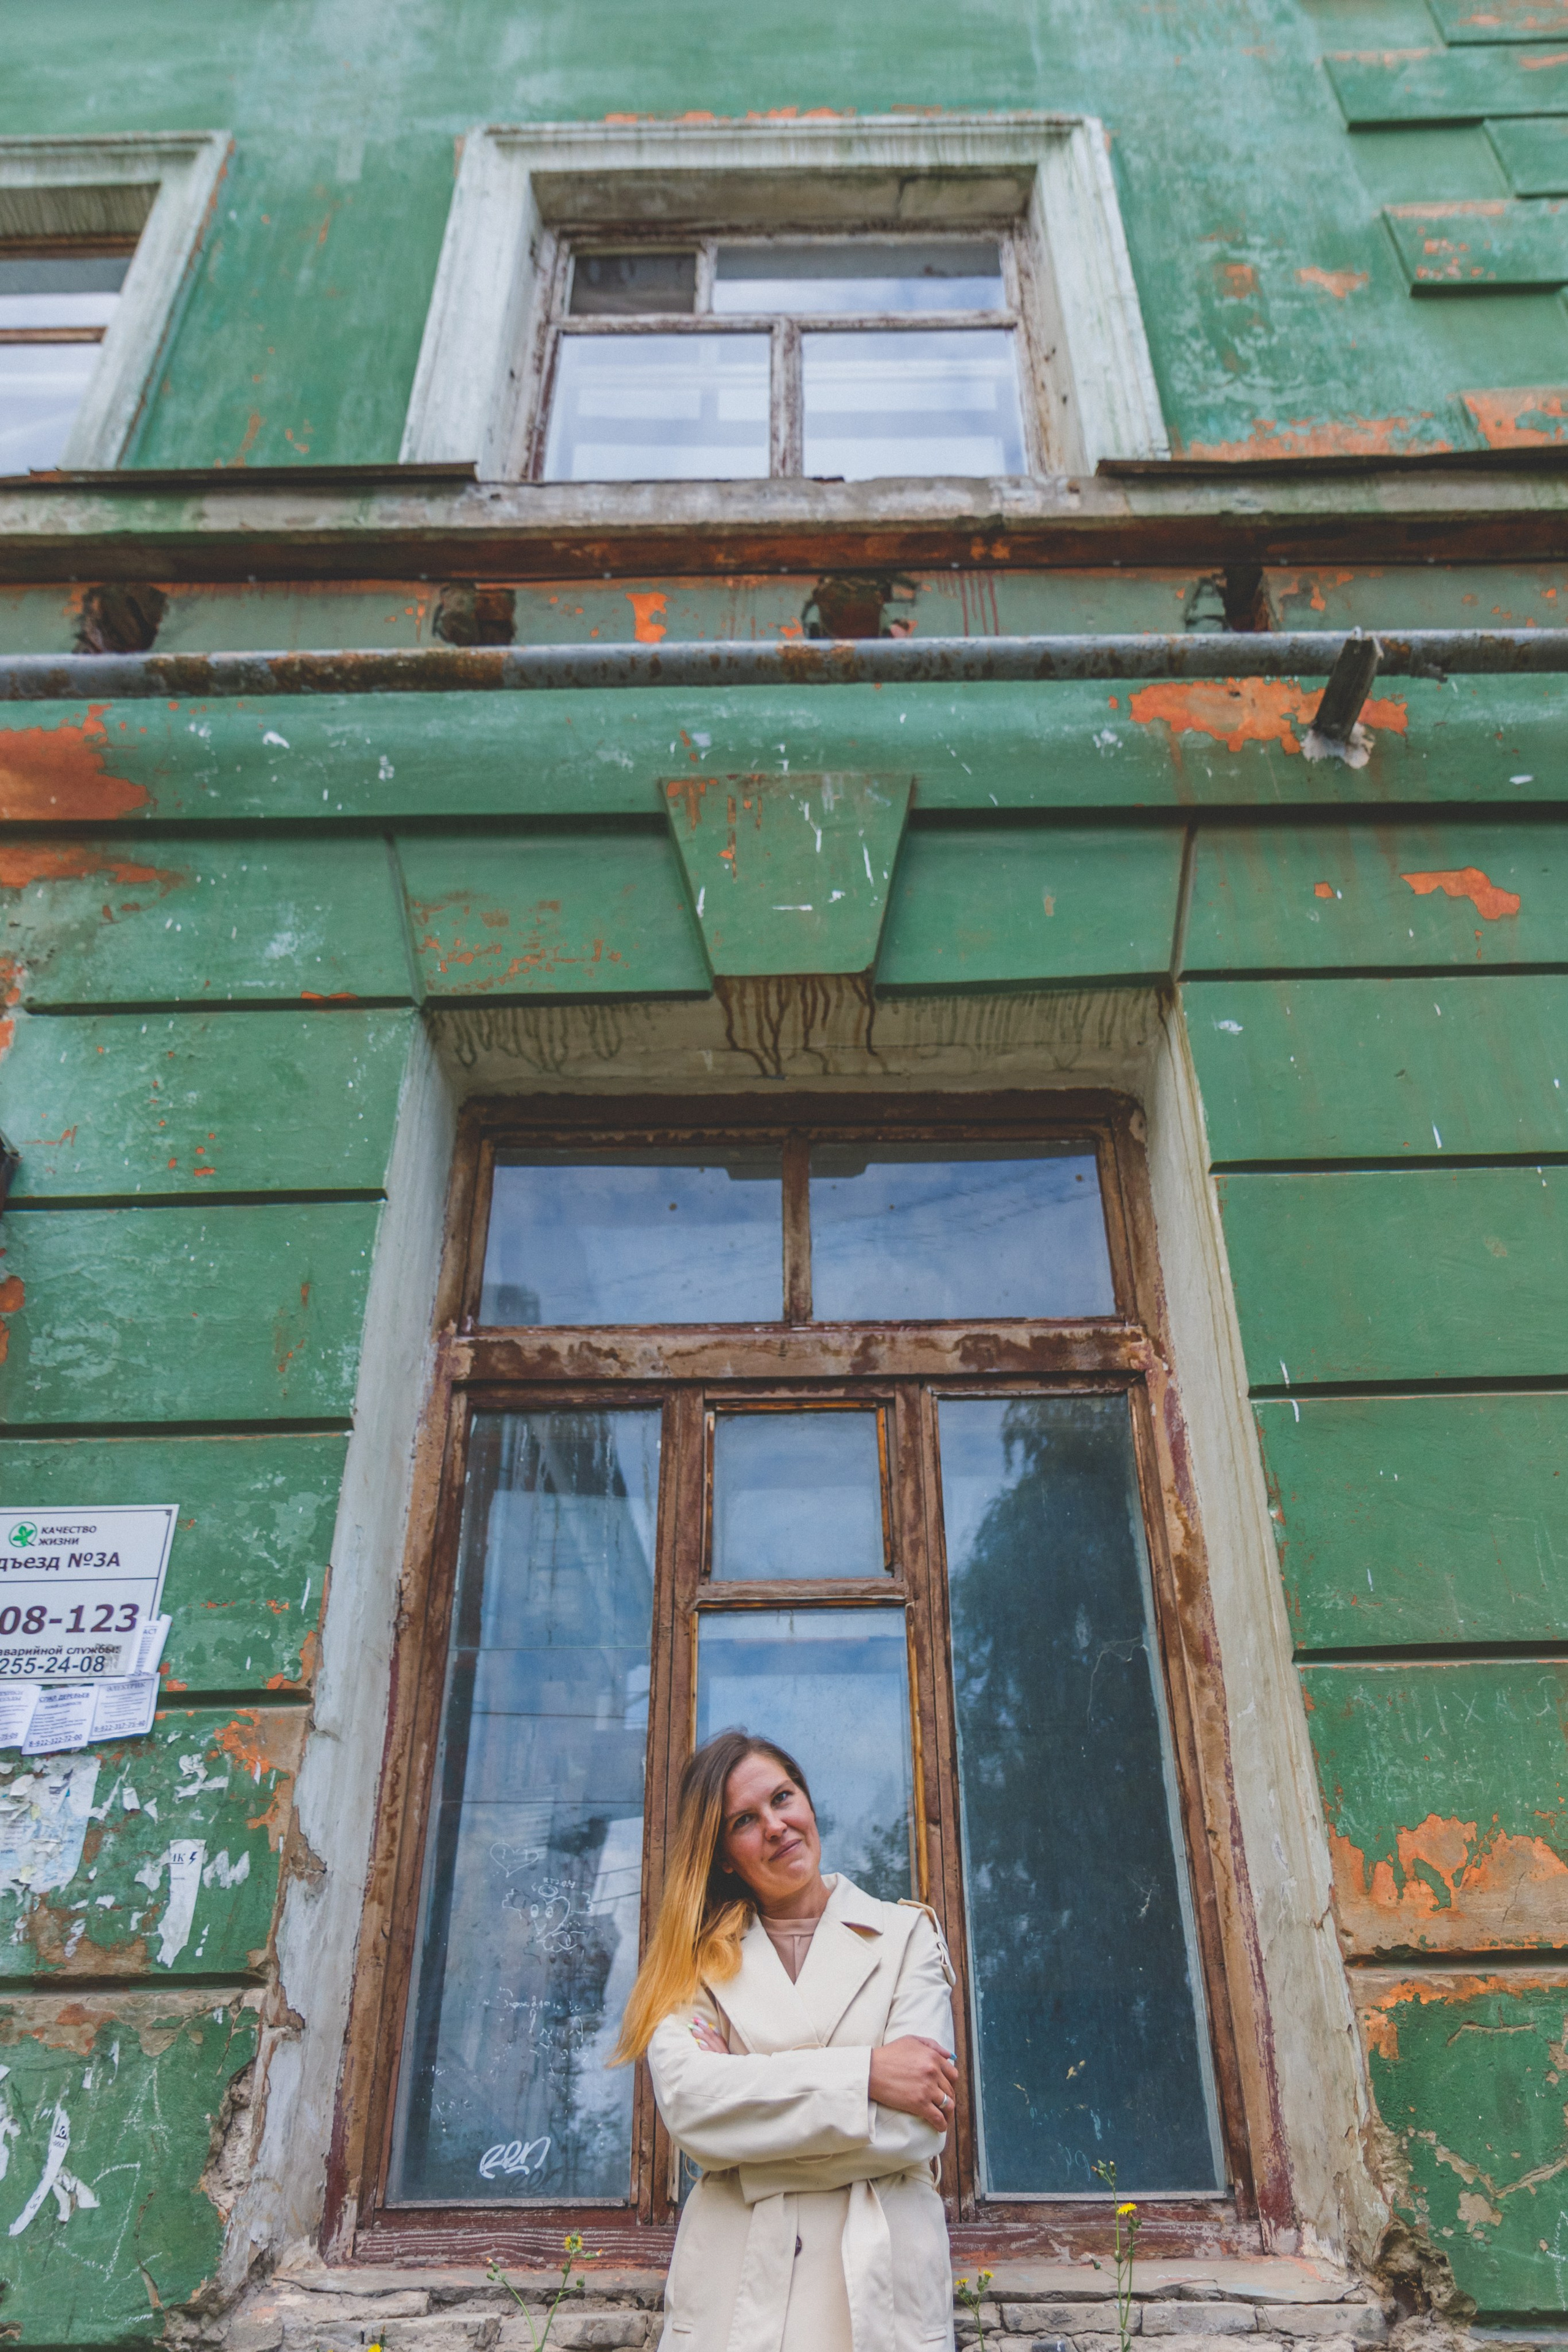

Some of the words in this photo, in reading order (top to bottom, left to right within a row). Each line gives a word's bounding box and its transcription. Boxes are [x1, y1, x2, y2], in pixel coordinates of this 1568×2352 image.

[41, 1526, 97, 1534] КАЧЕСТВО
[67, 1552, 120, 1567] №3А
[0, 1604, 140, 1635] 08-123
[0, 1656, 105, 1675] 255-24-08
